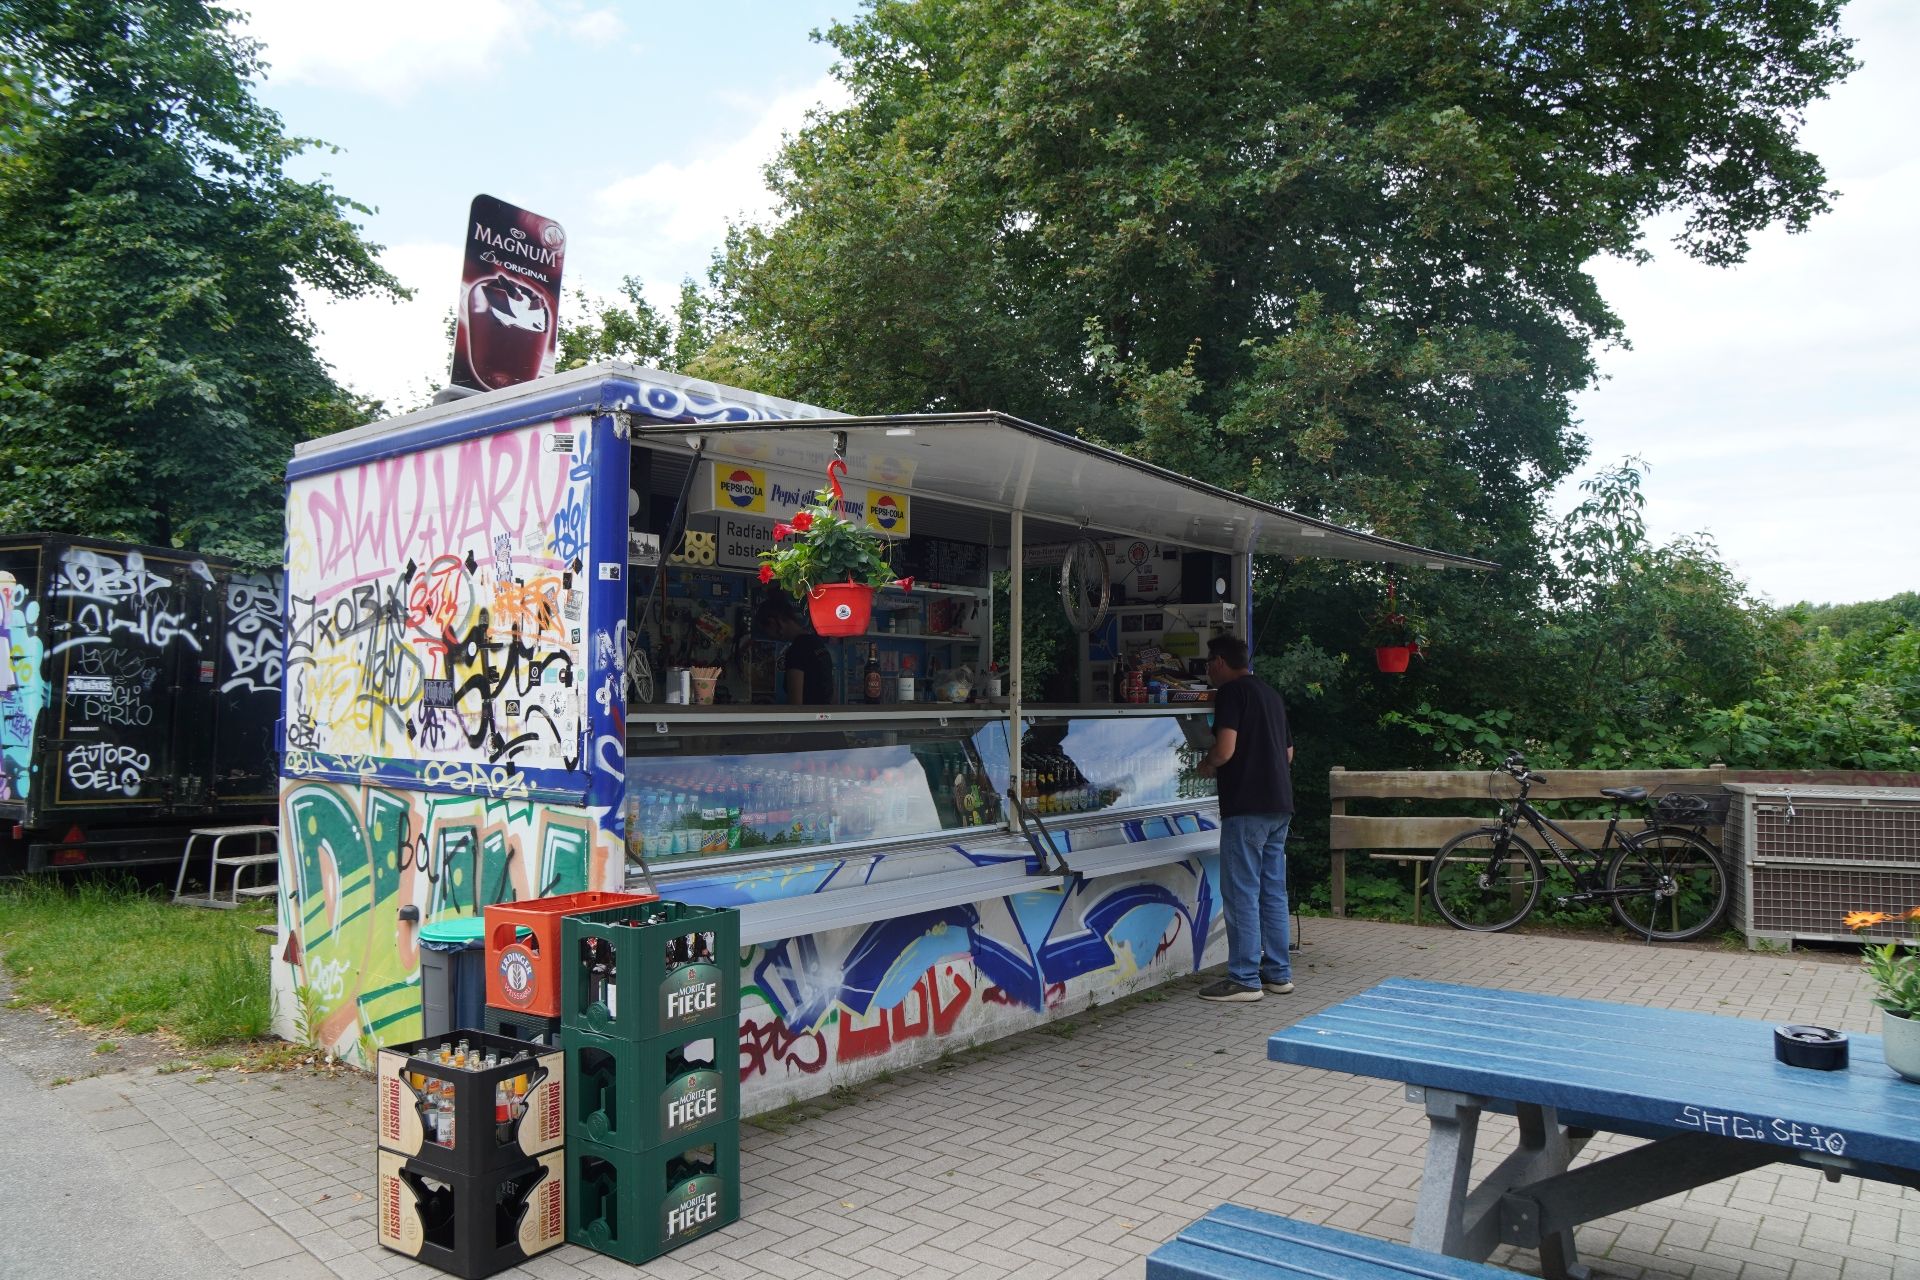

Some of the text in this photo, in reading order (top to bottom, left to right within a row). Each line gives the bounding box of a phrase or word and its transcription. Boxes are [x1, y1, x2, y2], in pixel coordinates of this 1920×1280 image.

[474, 222, 556, 268] MAGNUM
[503, 261, 550, 283] ORIGINAL
[770, 484, 800, 507] Pepsi
[501, 952, 532, 974] ERDINGER
[667, 982, 717, 1019] FIEGE
[679, 982, 706, 996] MORITZ
[389, 1077, 400, 1141] FASSBRAUSE
[548, 1080, 561, 1139] FASSBRAUSE
[668, 1088, 717, 1128] FIEGE
[679, 1088, 706, 1104] MORITZ
[390, 1176, 401, 1240] FASSBRAUSE
[549, 1179, 561, 1238] FASSBRAUSE
[668, 1191, 717, 1236] FIEGE
[679, 1193, 706, 1211] MORITZ
